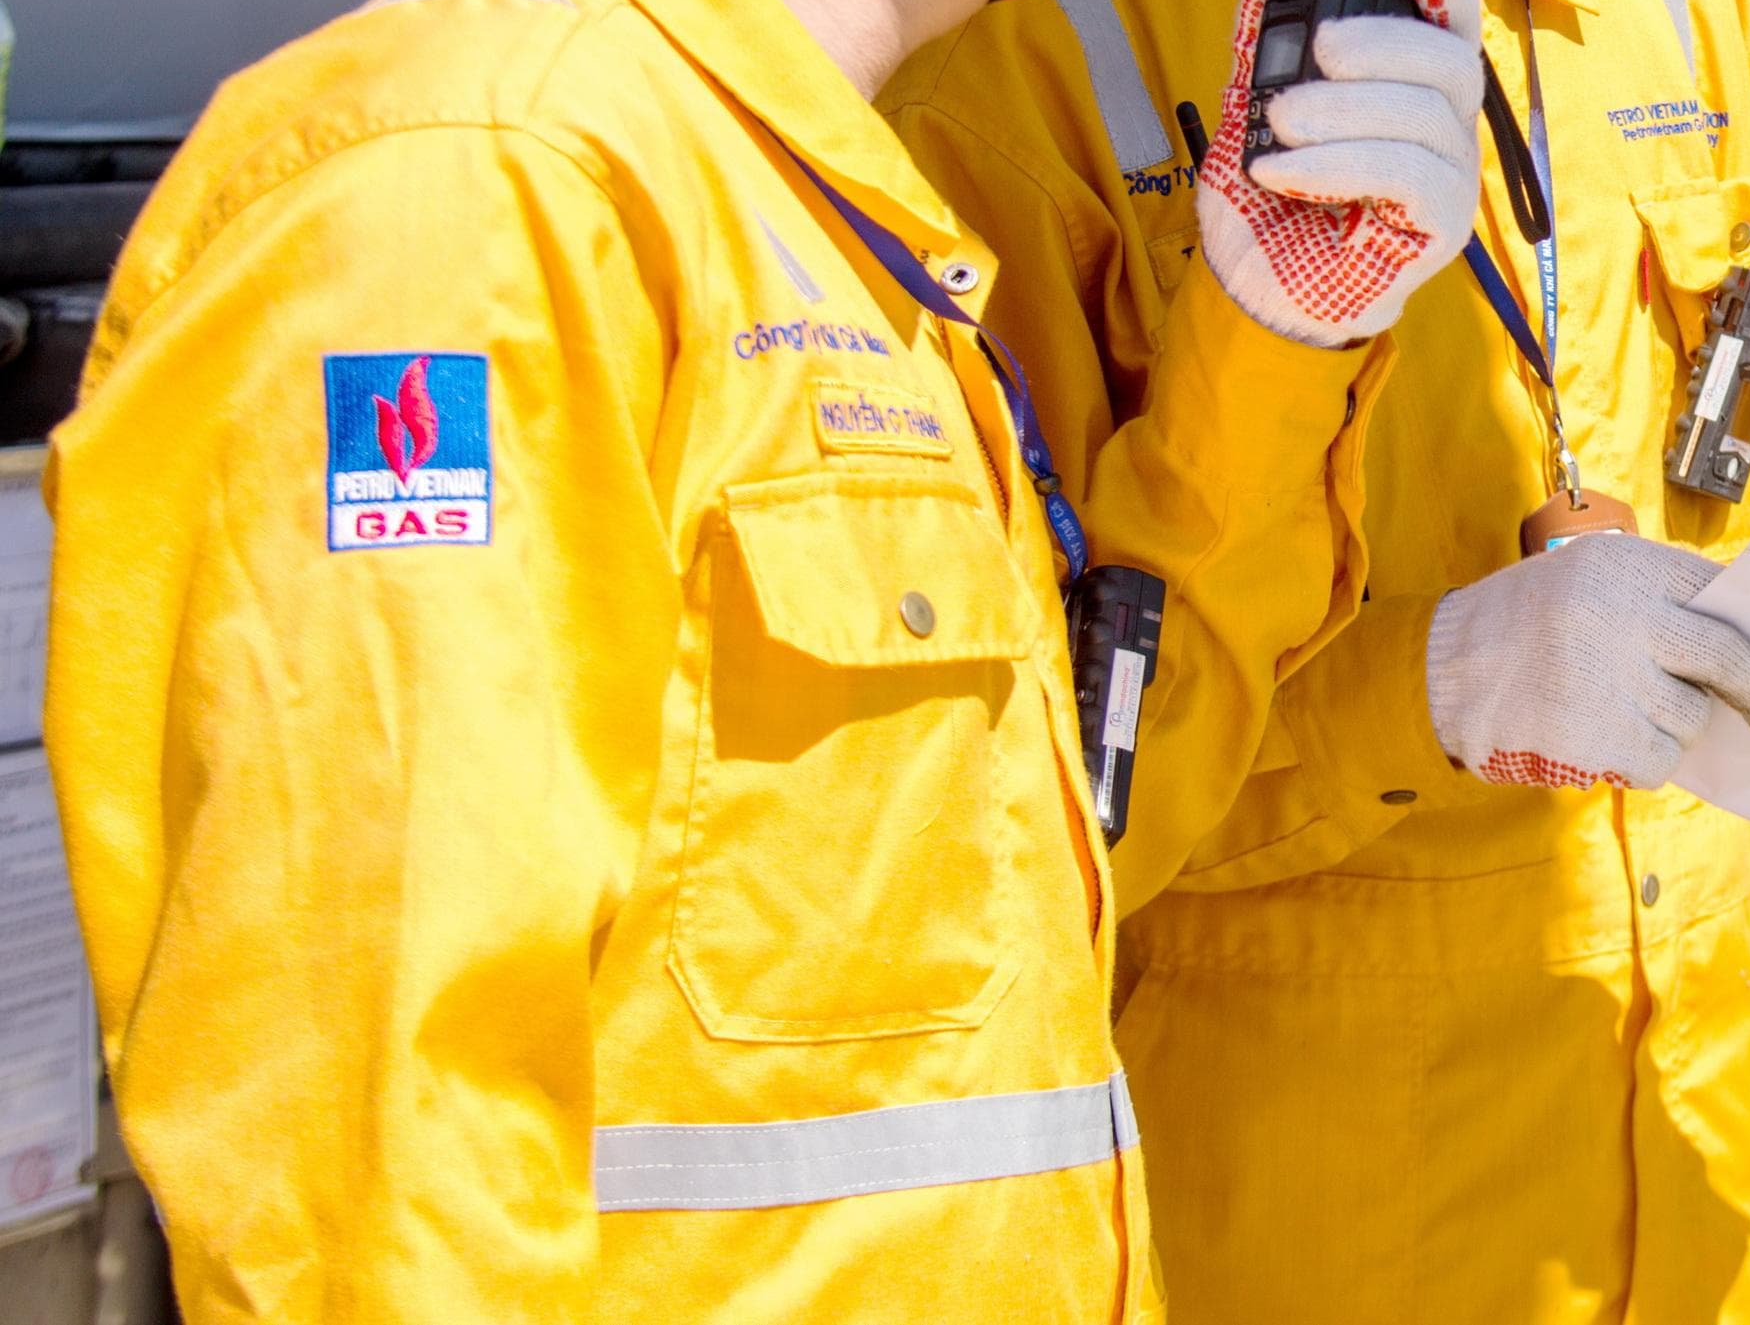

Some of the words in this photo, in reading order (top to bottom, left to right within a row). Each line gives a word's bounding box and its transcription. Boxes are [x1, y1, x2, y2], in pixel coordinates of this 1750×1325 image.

[1607, 107, 1645, 127] PETRO
[1645, 100, 1699, 119] VIETNAM
[734, 322, 805, 360] Công
[357, 509, 469, 540] GAS
